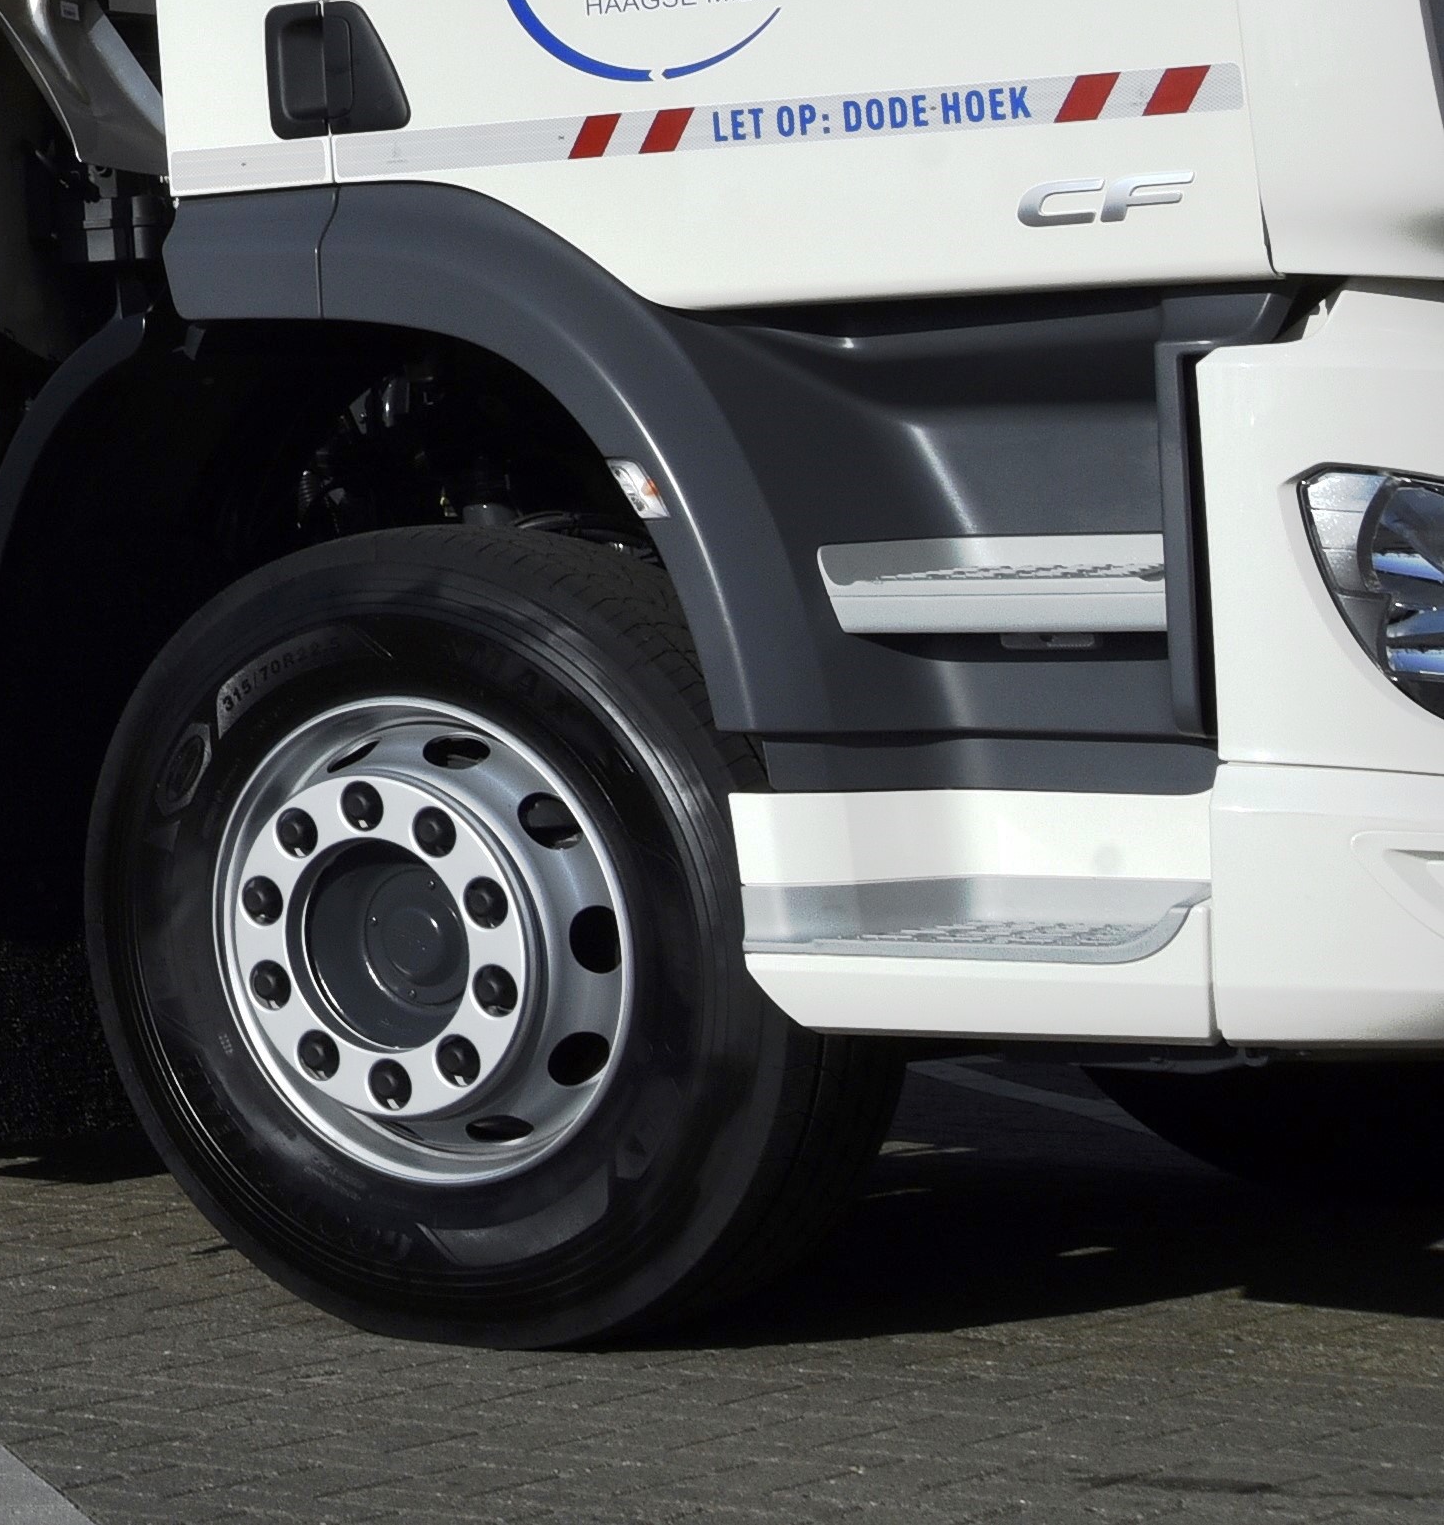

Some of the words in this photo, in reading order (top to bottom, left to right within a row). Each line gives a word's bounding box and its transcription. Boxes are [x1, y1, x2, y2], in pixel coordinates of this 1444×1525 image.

[712, 107, 764, 143] LET
[776, 103, 831, 138] OP:
[842, 94, 929, 133] DODE
[940, 85, 1032, 125] HOEK
[1017, 171, 1195, 228] CF
